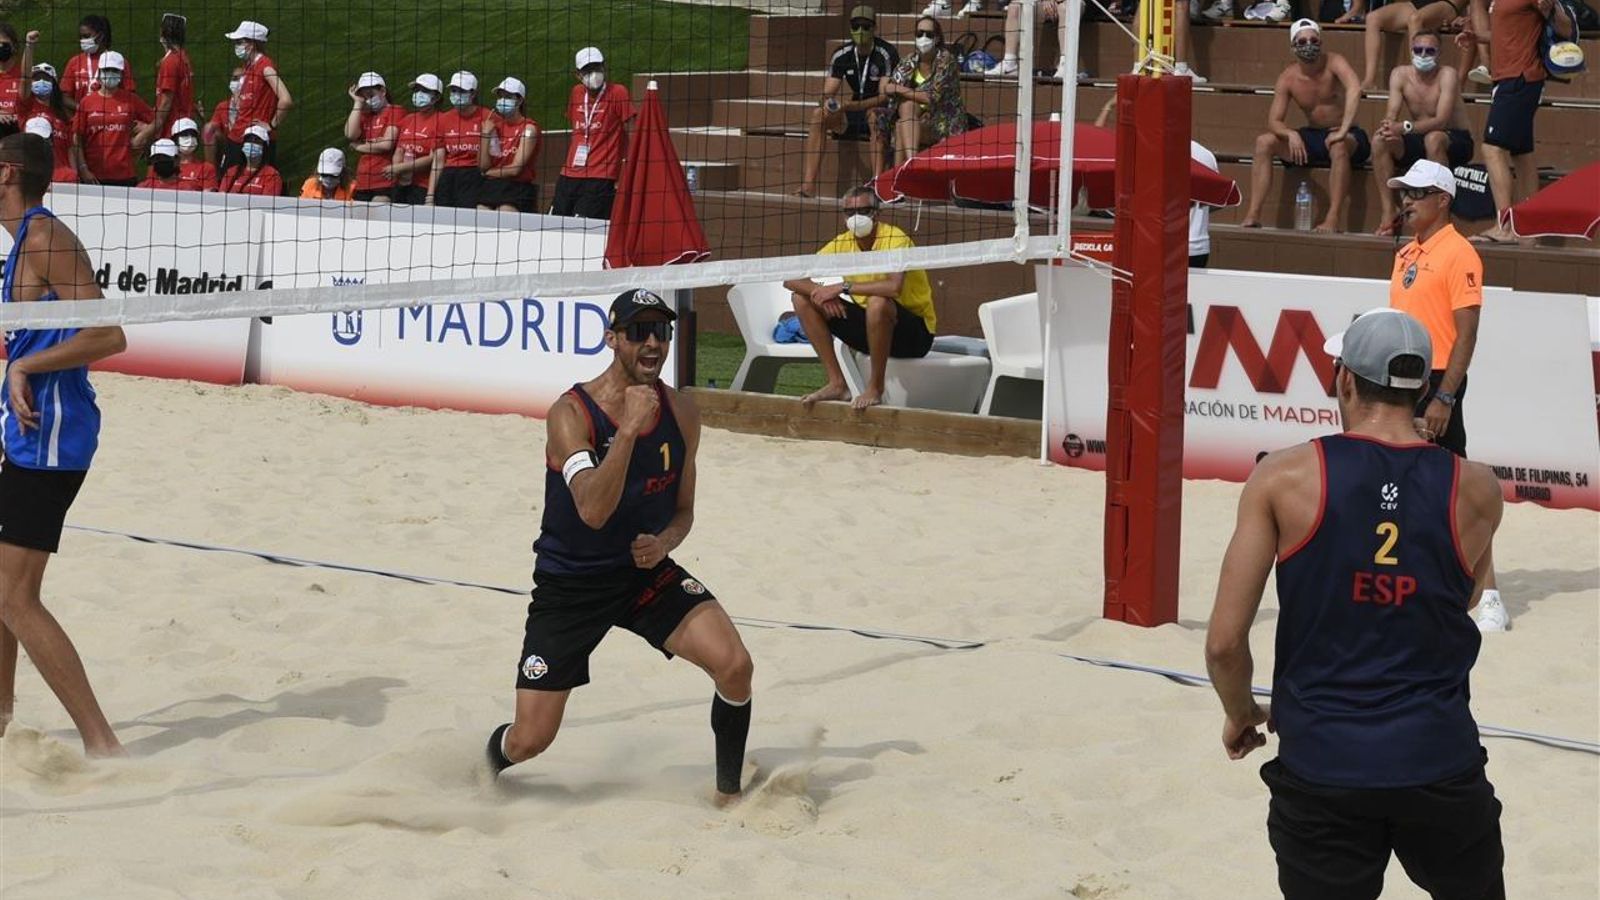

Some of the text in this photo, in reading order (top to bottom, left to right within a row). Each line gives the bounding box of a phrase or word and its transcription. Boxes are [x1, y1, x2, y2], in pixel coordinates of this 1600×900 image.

[117, 264, 147, 293] de
[155, 268, 242, 295] Madrid
[398, 298, 610, 356] MADRID
[1239, 404, 1259, 420] DE
[1263, 405, 1339, 426] MADRI
[659, 442, 670, 472] 1
[1491, 465, 1588, 488] NIDA DE FILIPINAS, 54
[1381, 502, 1398, 511] CEV
[1515, 485, 1551, 501] MADRID
[1374, 521, 1399, 565] 2
[1353, 571, 1418, 607] ESP
